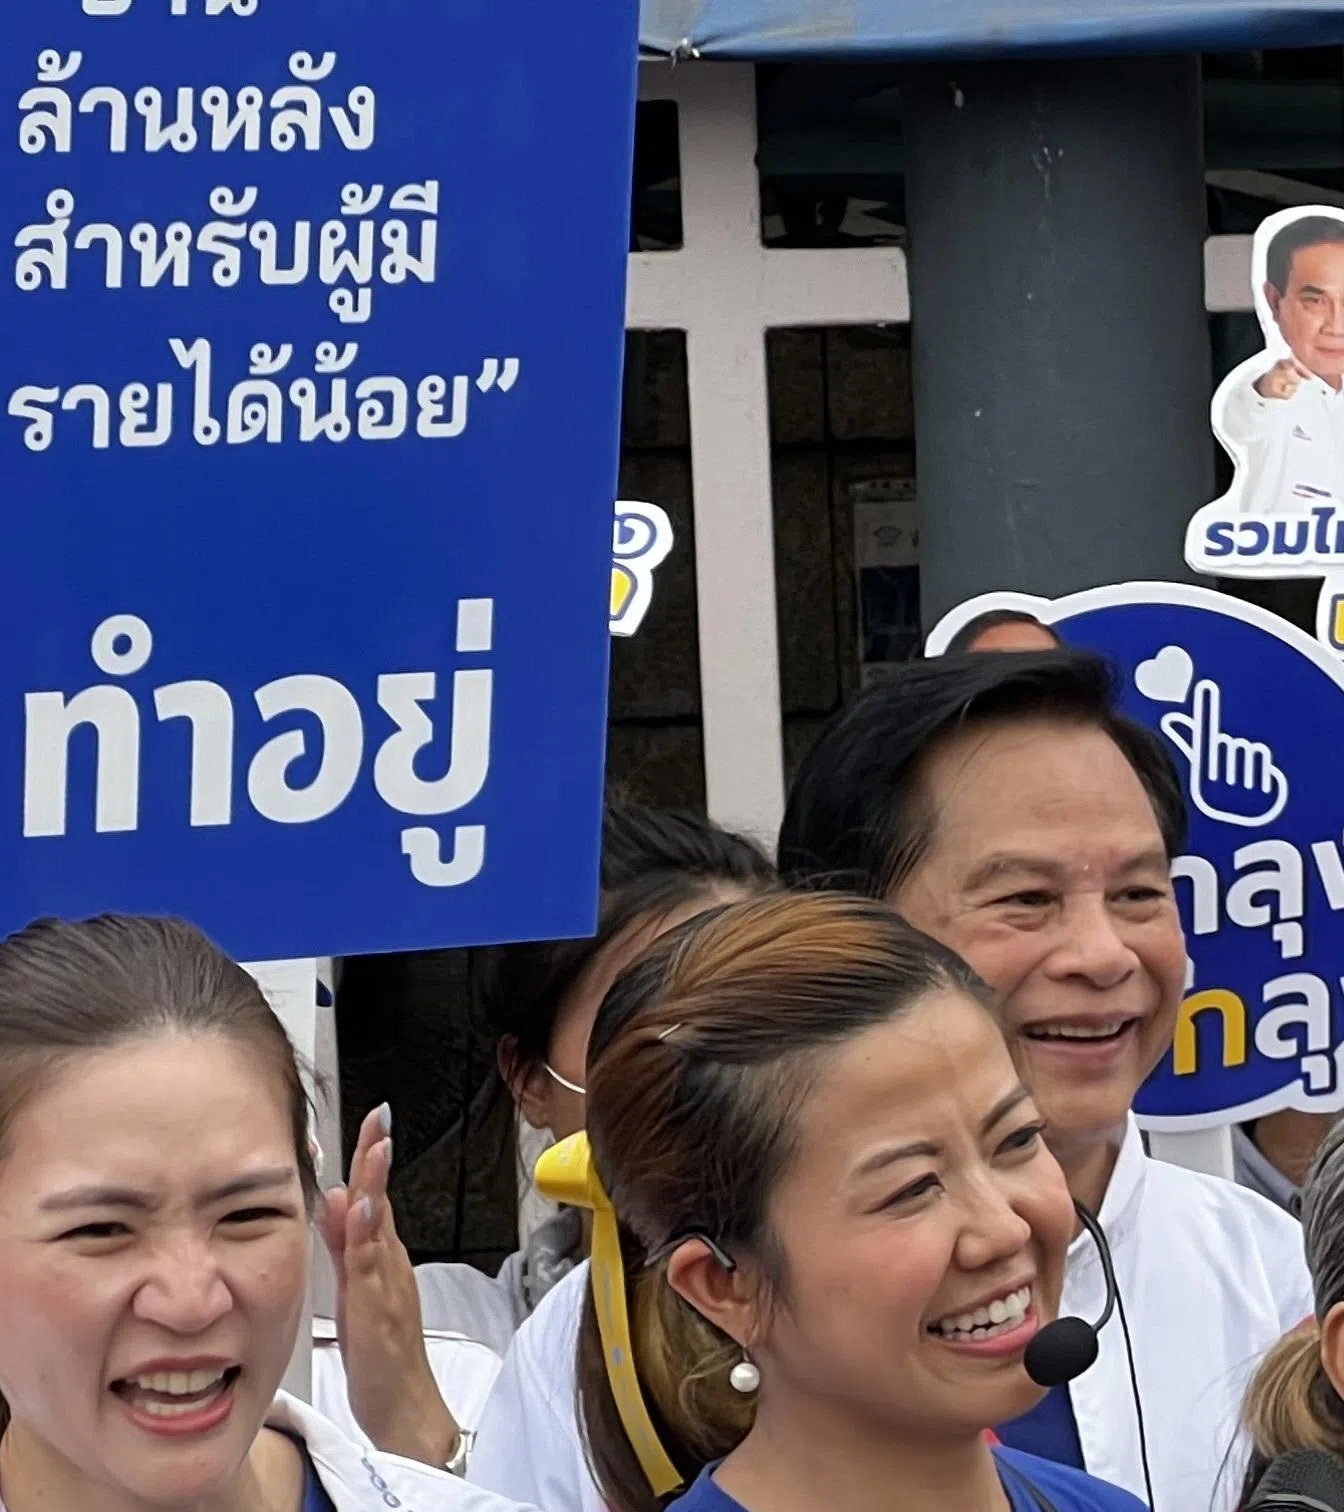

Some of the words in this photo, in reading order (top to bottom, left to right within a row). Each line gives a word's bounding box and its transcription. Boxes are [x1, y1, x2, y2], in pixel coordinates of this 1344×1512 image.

[18, 49, 375, 154] ล้านหลัง
[14, 180, 440, 324] สำหรับผู้มี
[7, 338, 520, 452] รายได้น้อย”
[23, 597, 494, 888] ทำอยู่
